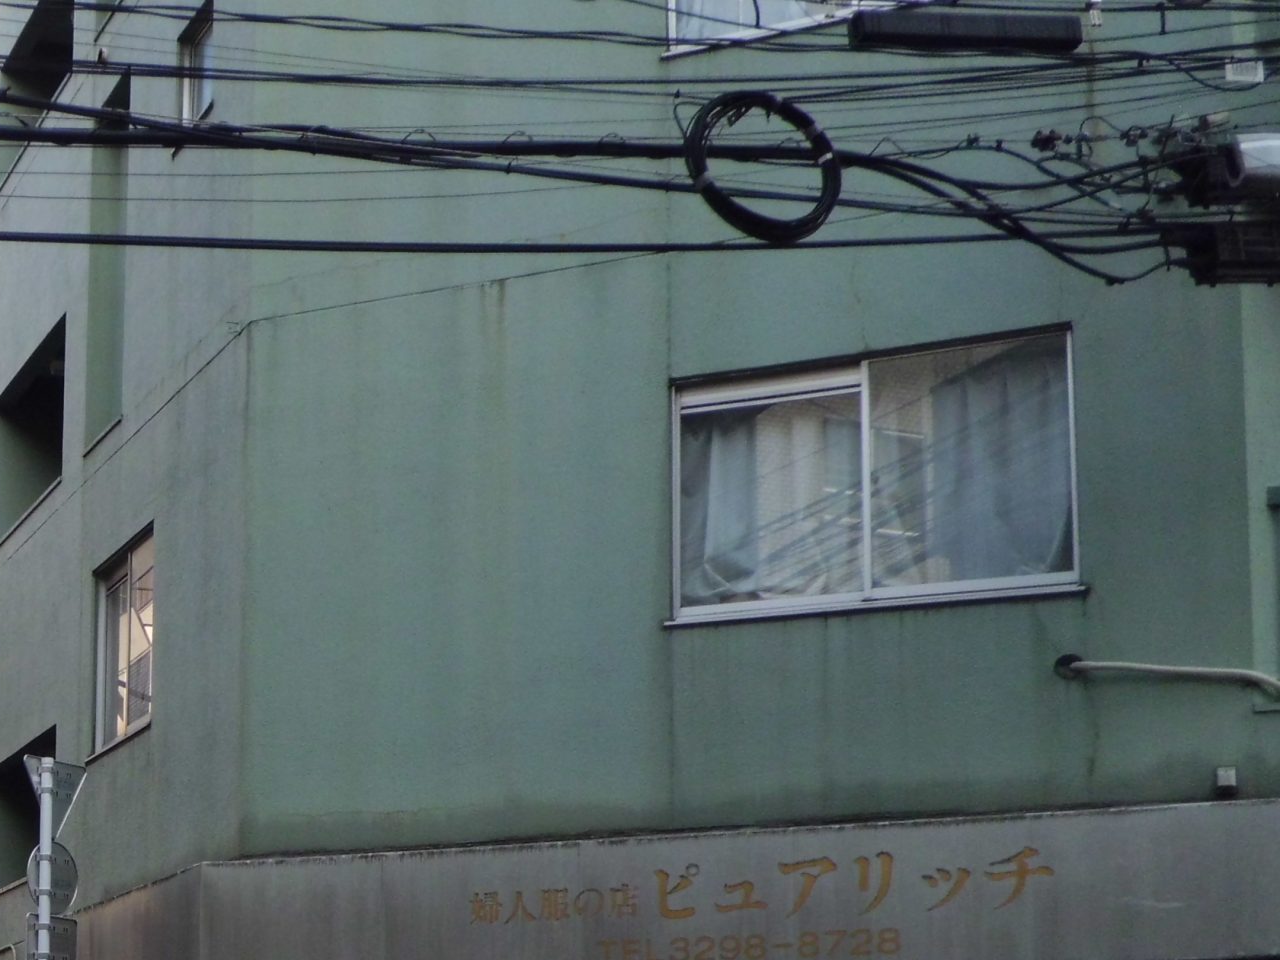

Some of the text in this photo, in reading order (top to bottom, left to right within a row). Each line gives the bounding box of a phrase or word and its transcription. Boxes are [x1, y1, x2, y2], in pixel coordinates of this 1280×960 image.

[469, 884, 639, 926] 婦人服の店
[654, 846, 1054, 920] ピュアリッチ
